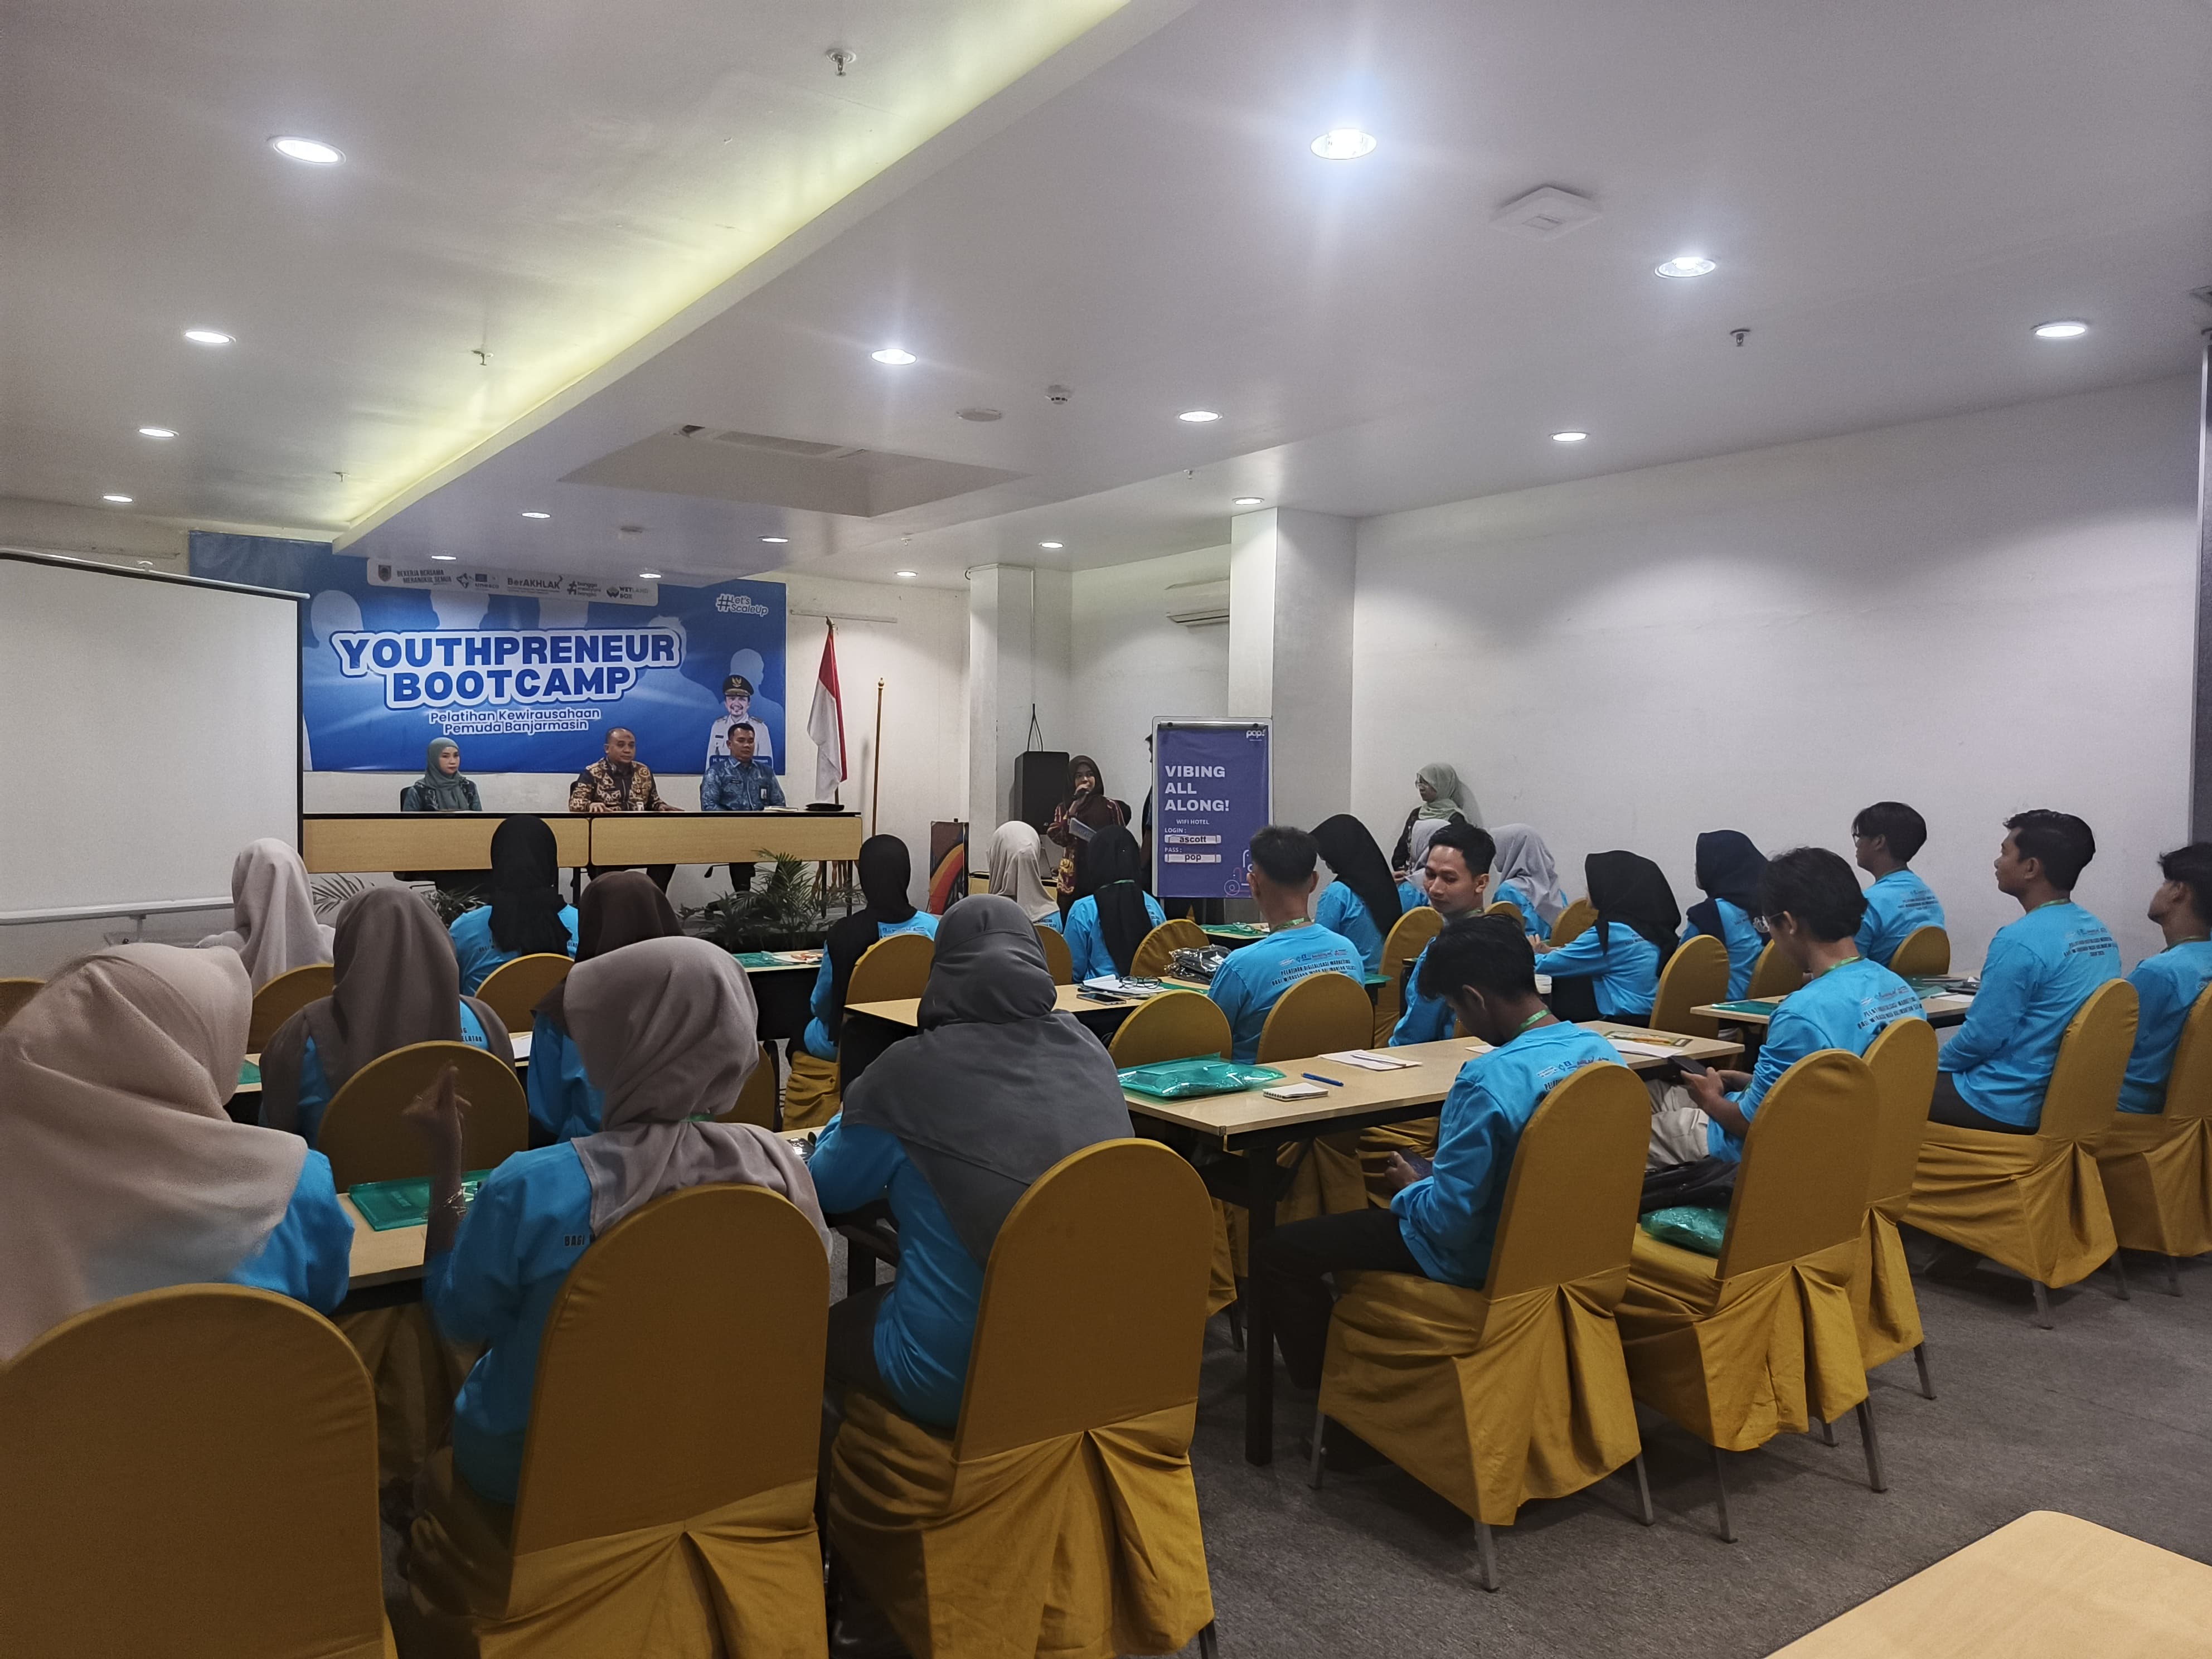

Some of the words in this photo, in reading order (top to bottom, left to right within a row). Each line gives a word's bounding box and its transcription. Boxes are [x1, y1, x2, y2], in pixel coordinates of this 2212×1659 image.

[339, 634, 675, 670] YOUTHPRENEUR
[393, 666, 630, 702] BOOTCAMP
[430, 711, 495, 722] Pelatihan
[499, 709, 600, 721] Kewirausahaan
[445, 723, 502, 734] Pemuda
[505, 720, 588, 734] Banjarmasin
[1246, 729, 1266, 739] pop!
[1165, 765, 1225, 778] VIBING
[1165, 783, 1197, 794] ALL
[1165, 799, 1230, 812] ALONG!
[1185, 854, 1201, 862] pop
[564, 1234, 585, 1246] BAGI
